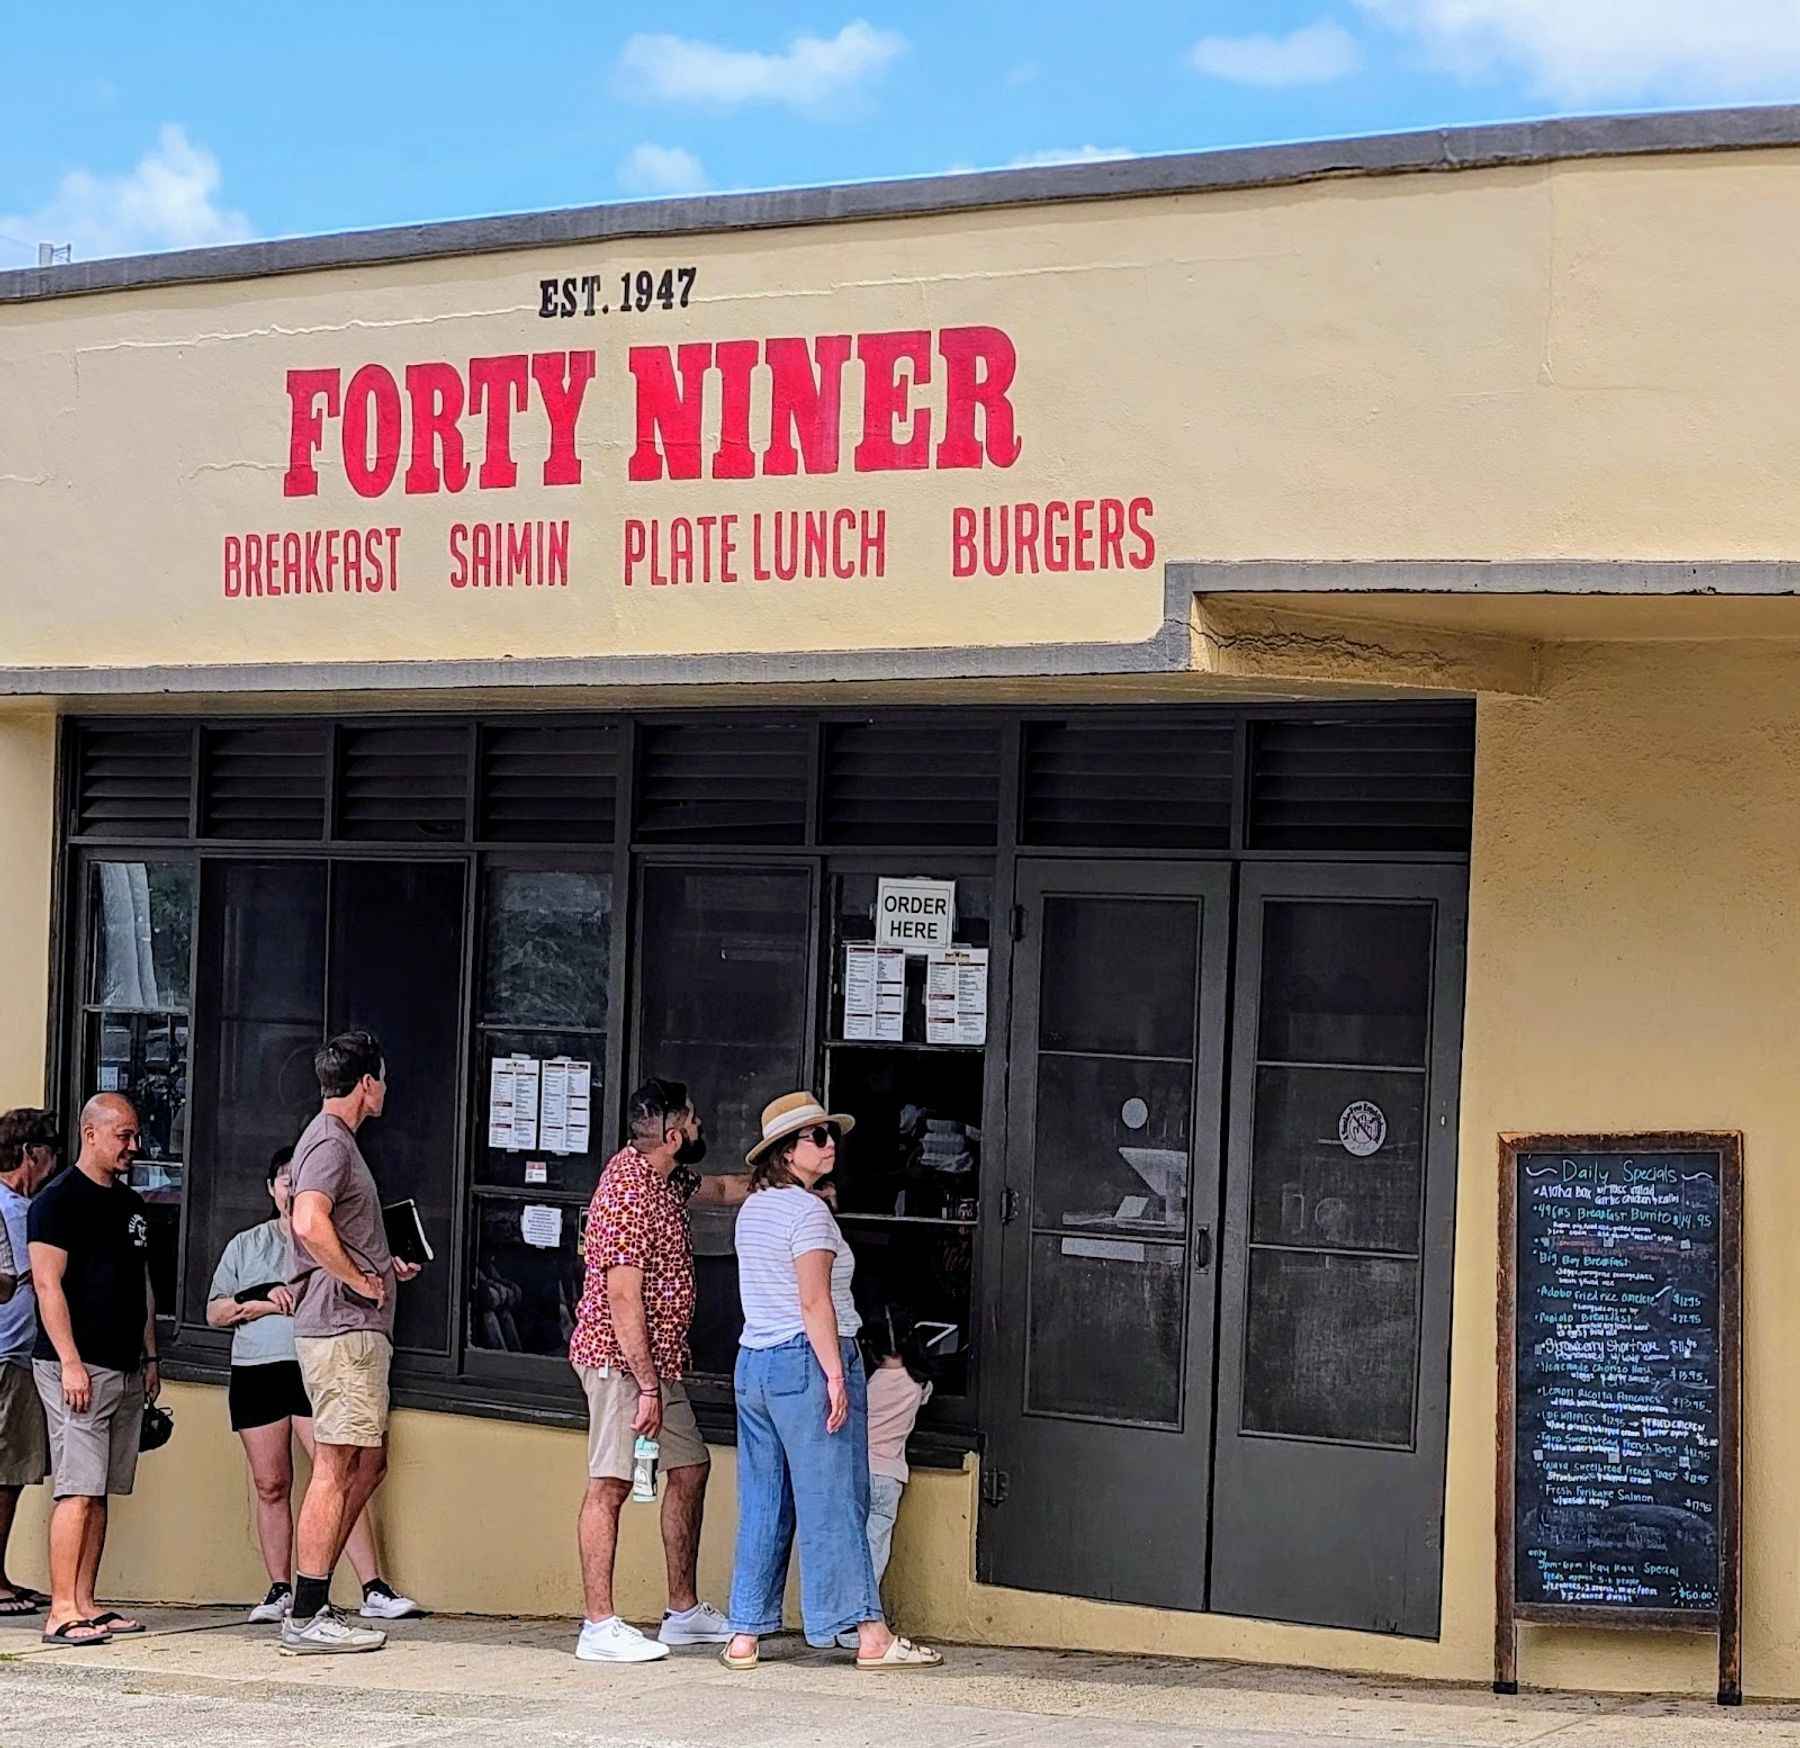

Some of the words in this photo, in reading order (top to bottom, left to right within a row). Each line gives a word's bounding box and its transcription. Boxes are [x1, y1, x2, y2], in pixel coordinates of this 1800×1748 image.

[538, 274, 609, 319] EST.
[620, 267, 697, 312] 1947
[284, 351, 595, 498] FORTY
[629, 326, 1021, 482] NINER
[225, 528, 401, 597] BREAKFAST
[450, 521, 569, 587] SAIMIN
[625, 515, 738, 585] PLATE
[754, 509, 886, 580] LUNCH
[953, 497, 1155, 577] BURGERS
[884, 895, 947, 916] ORDER
[890, 920, 938, 939] HERE
[1562, 1159, 1609, 1184] Daily
[1623, 1159, 1678, 1186] Specials
[1539, 1252, 1557, 1267] Big
[1541, 1285, 1572, 1298] Adobo
[1542, 1385, 1574, 1397] Lemon
[1545, 1484, 1572, 1496] Fresh
[1617, 1488, 1653, 1504] Salmon
[1643, 1561, 1680, 1577] Special
